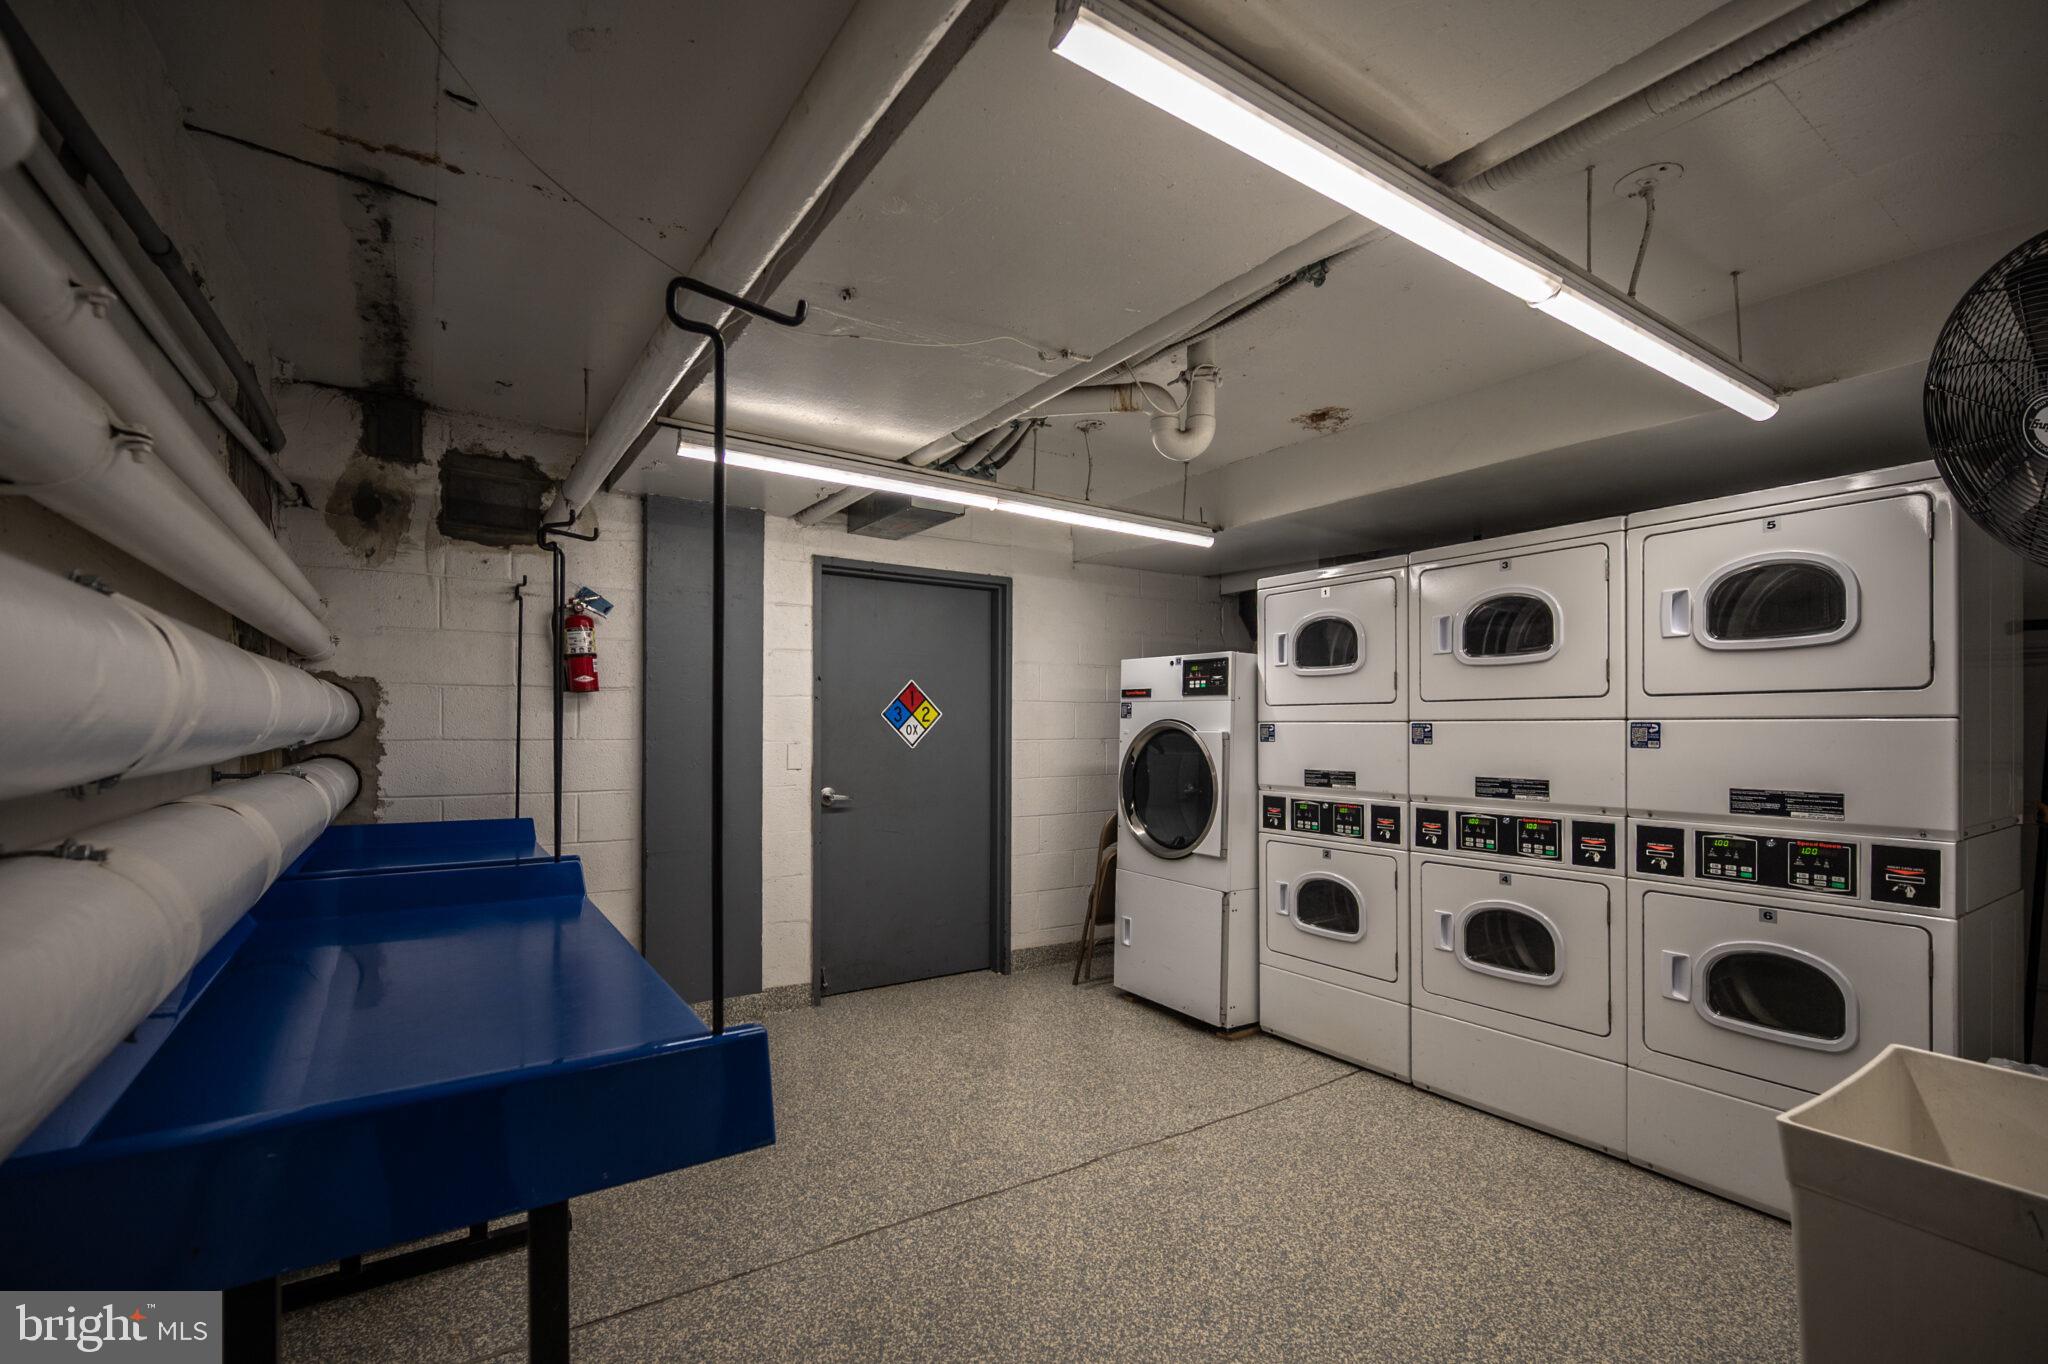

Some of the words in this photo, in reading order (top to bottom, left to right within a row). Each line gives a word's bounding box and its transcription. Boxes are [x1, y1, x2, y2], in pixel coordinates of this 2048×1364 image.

[1767, 520, 1777, 529] 5
[1502, 561, 1509, 569] 3
[893, 706, 903, 722] 3
[922, 706, 931, 722] 2
[905, 724, 919, 736] OX
[1323, 850, 1330, 858] 2
[1501, 875, 1510, 883] 4
[1763, 911, 1774, 920] 6
